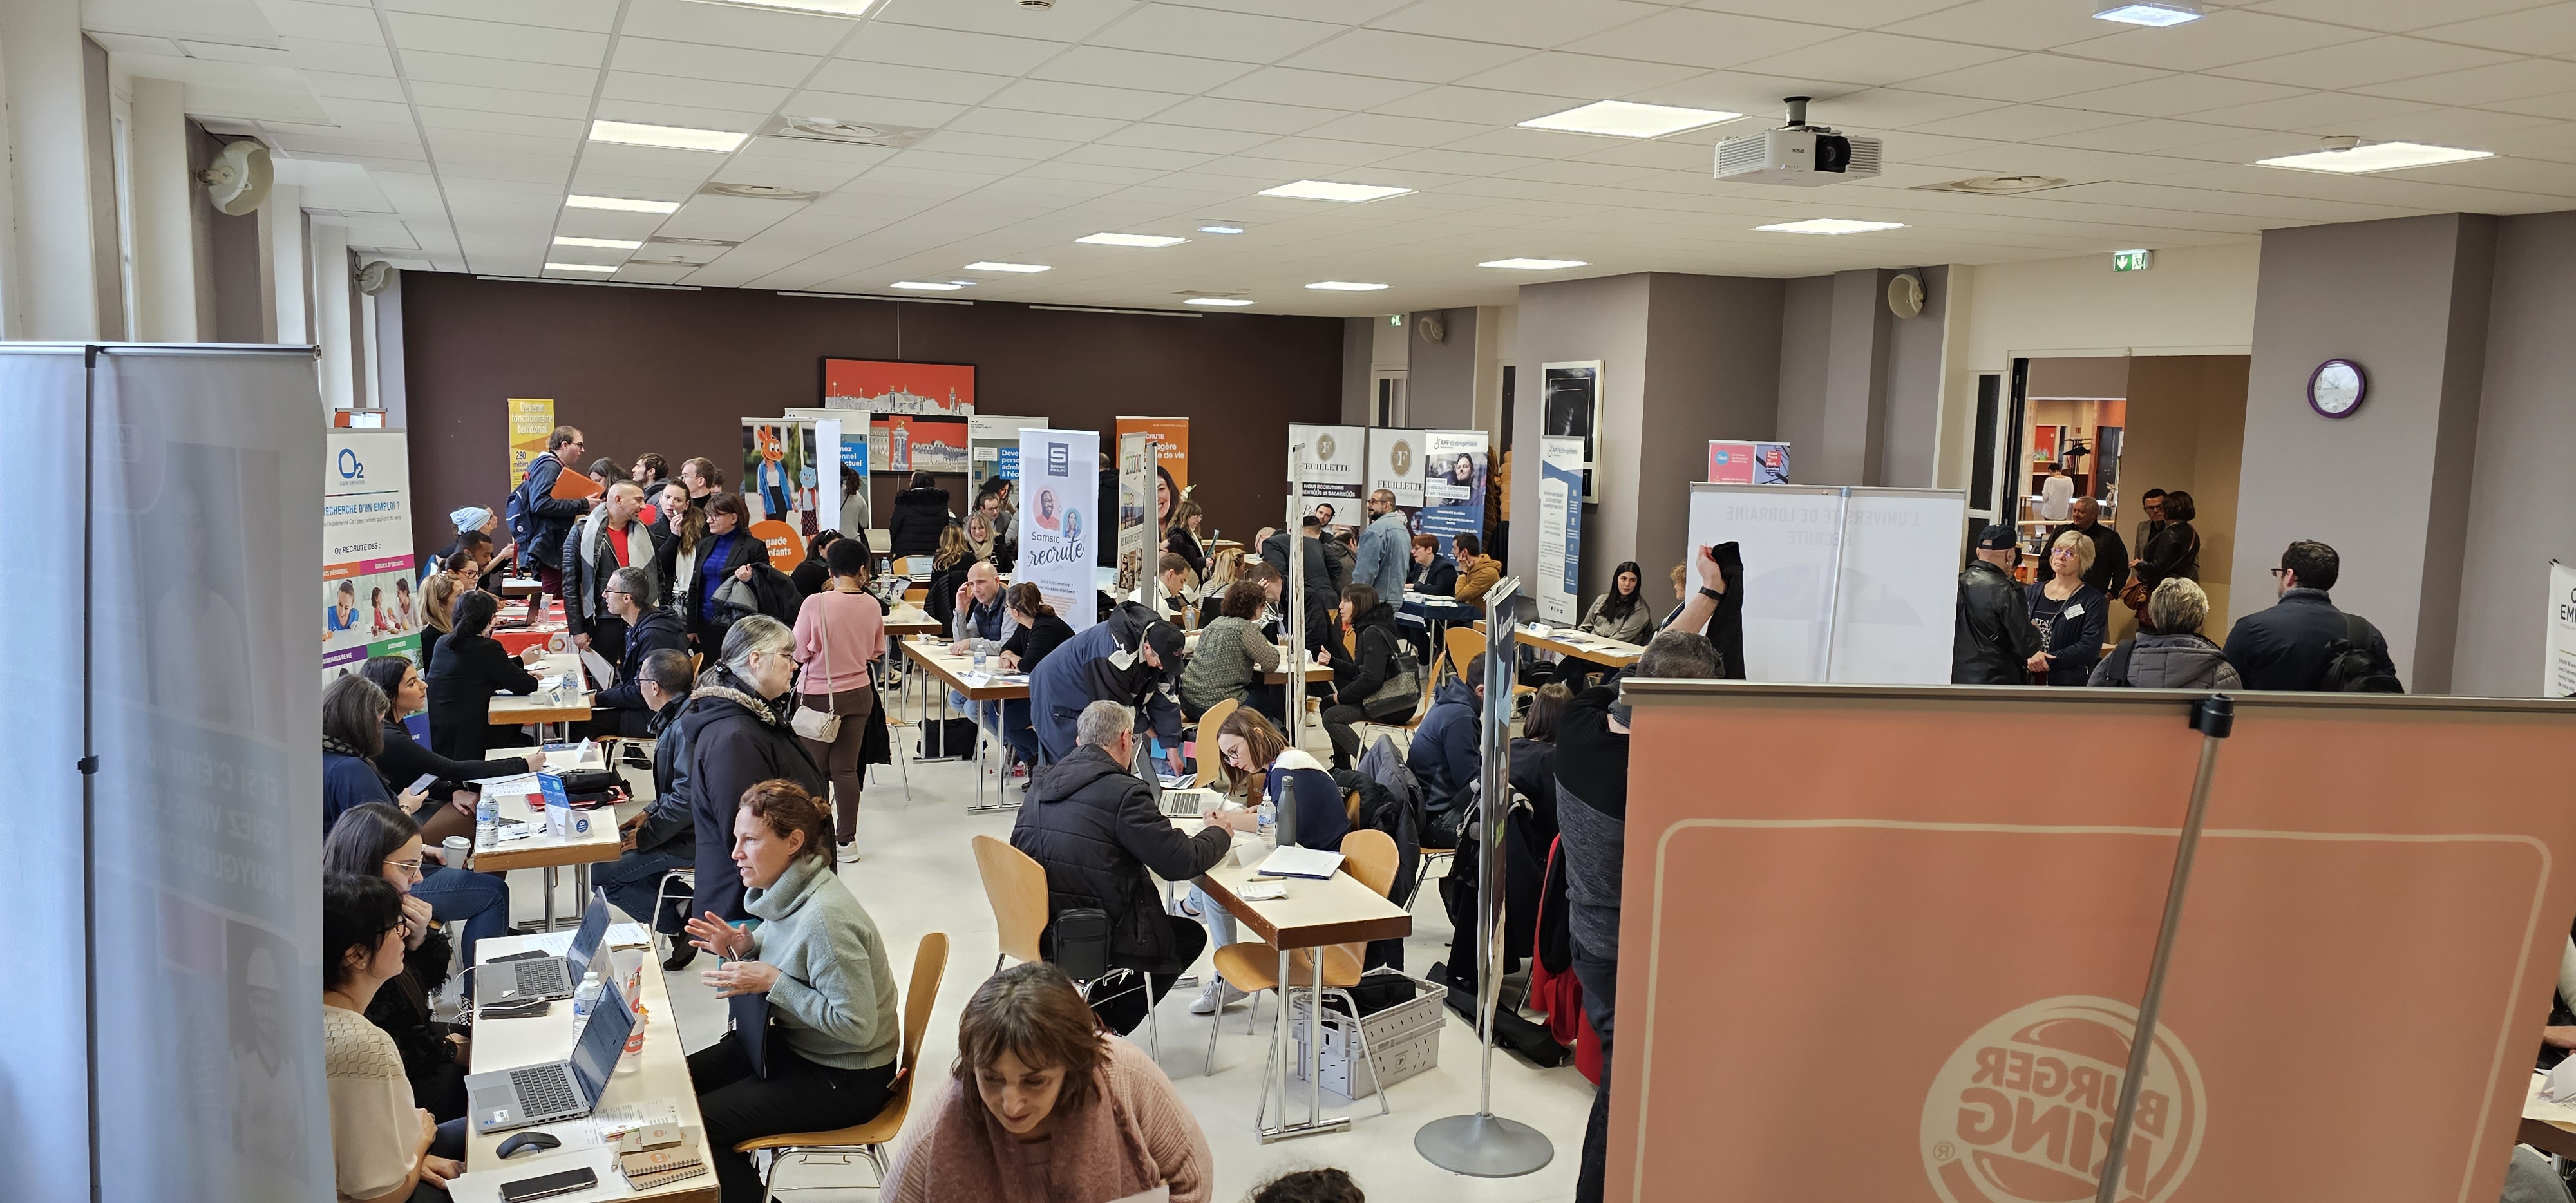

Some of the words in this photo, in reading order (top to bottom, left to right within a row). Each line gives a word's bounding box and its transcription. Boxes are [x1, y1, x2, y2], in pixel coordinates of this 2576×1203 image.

[520, 401, 544, 413] Devenir
[511, 413, 553, 424] fonctionnaire
[518, 423, 547, 435] territorial
[516, 451, 526, 460] 280
[1378, 480, 1423, 491] FEUILLETTE
[359, 503, 372, 513] D'UN
[374, 501, 395, 512] EMPLOI
[397, 501, 400, 509] ?
[765, 536, 787, 548] garde
[1032, 531, 1061, 544] Samsic
[343, 544, 368, 553] RECRUTE
[1028, 535, 1085, 567] recrute
